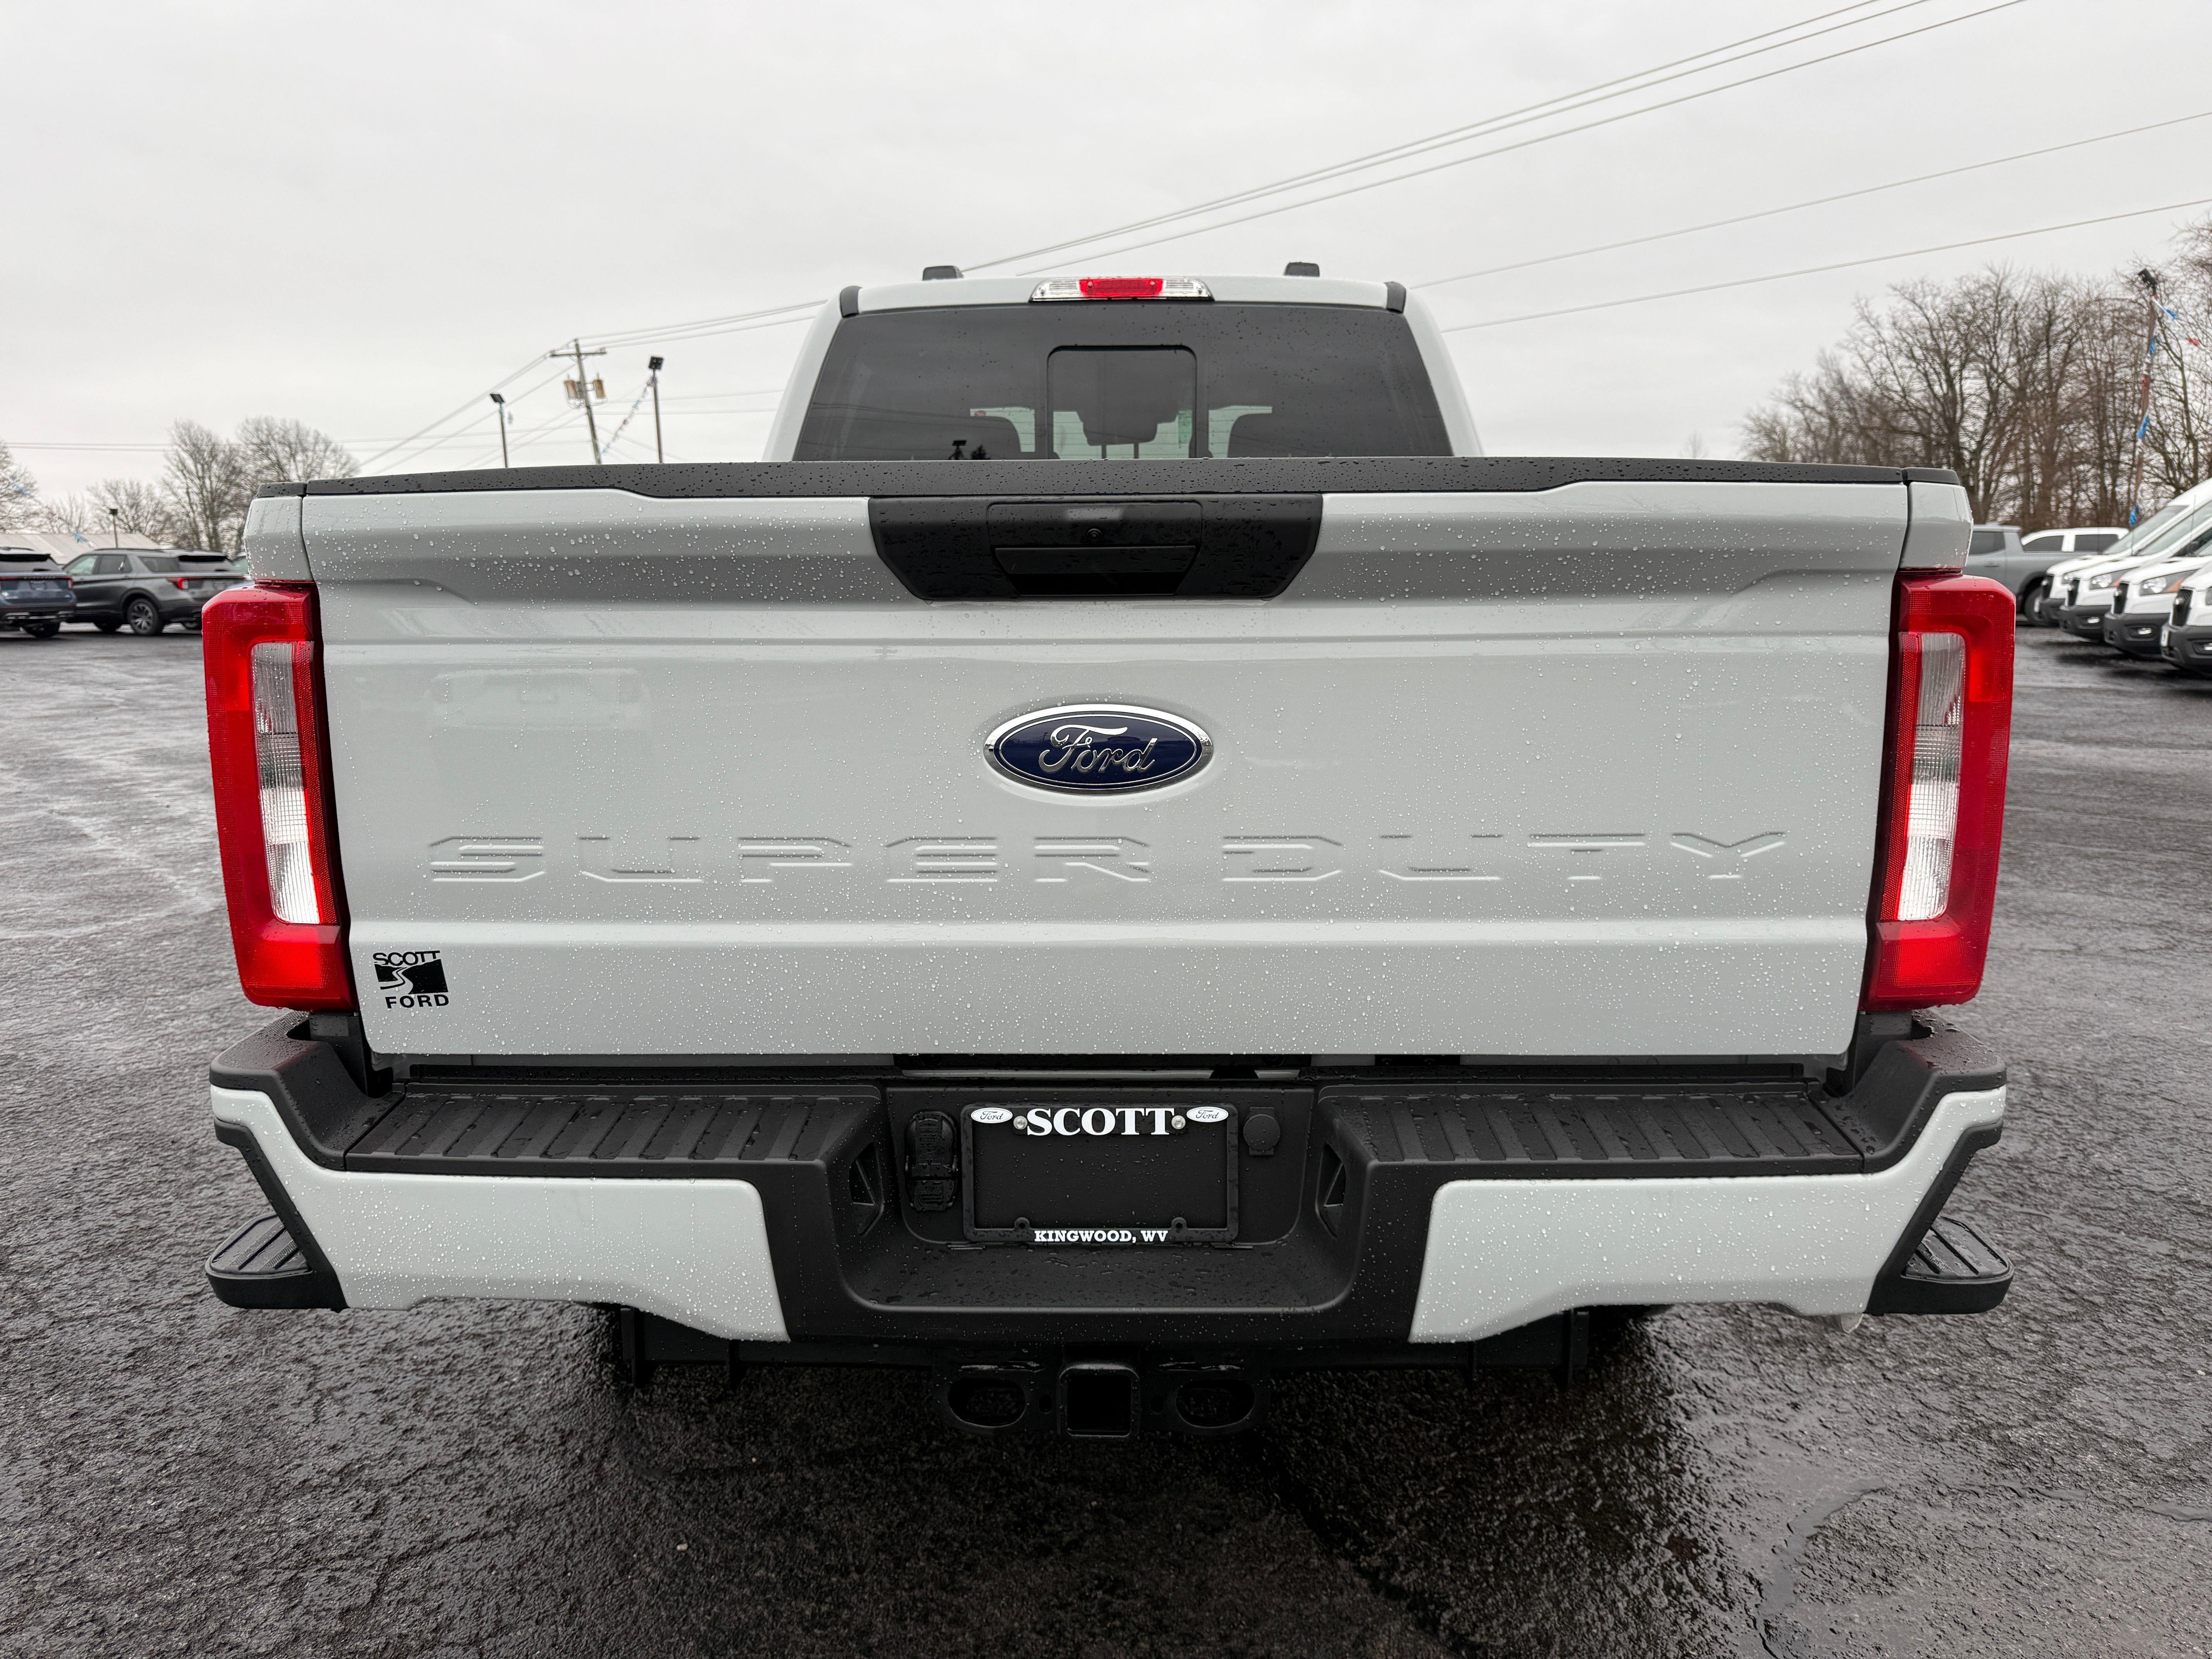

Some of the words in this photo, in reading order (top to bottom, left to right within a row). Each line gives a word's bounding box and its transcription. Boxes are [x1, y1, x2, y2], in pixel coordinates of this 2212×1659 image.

[1038, 724, 1159, 773] Ford
[428, 835, 1149, 883] SUPER
[1222, 833, 1786, 881] DUTY
[373, 950, 440, 966] SCOTT
[385, 994, 449, 1009] FORD
[980, 1111, 1003, 1120] Ford
[1196, 1109, 1219, 1119] Ford
[1027, 1108, 1175, 1136] SCOTT
[1034, 1230, 1137, 1243] KINGWOOD,
[1140, 1230, 1168, 1242] WV
